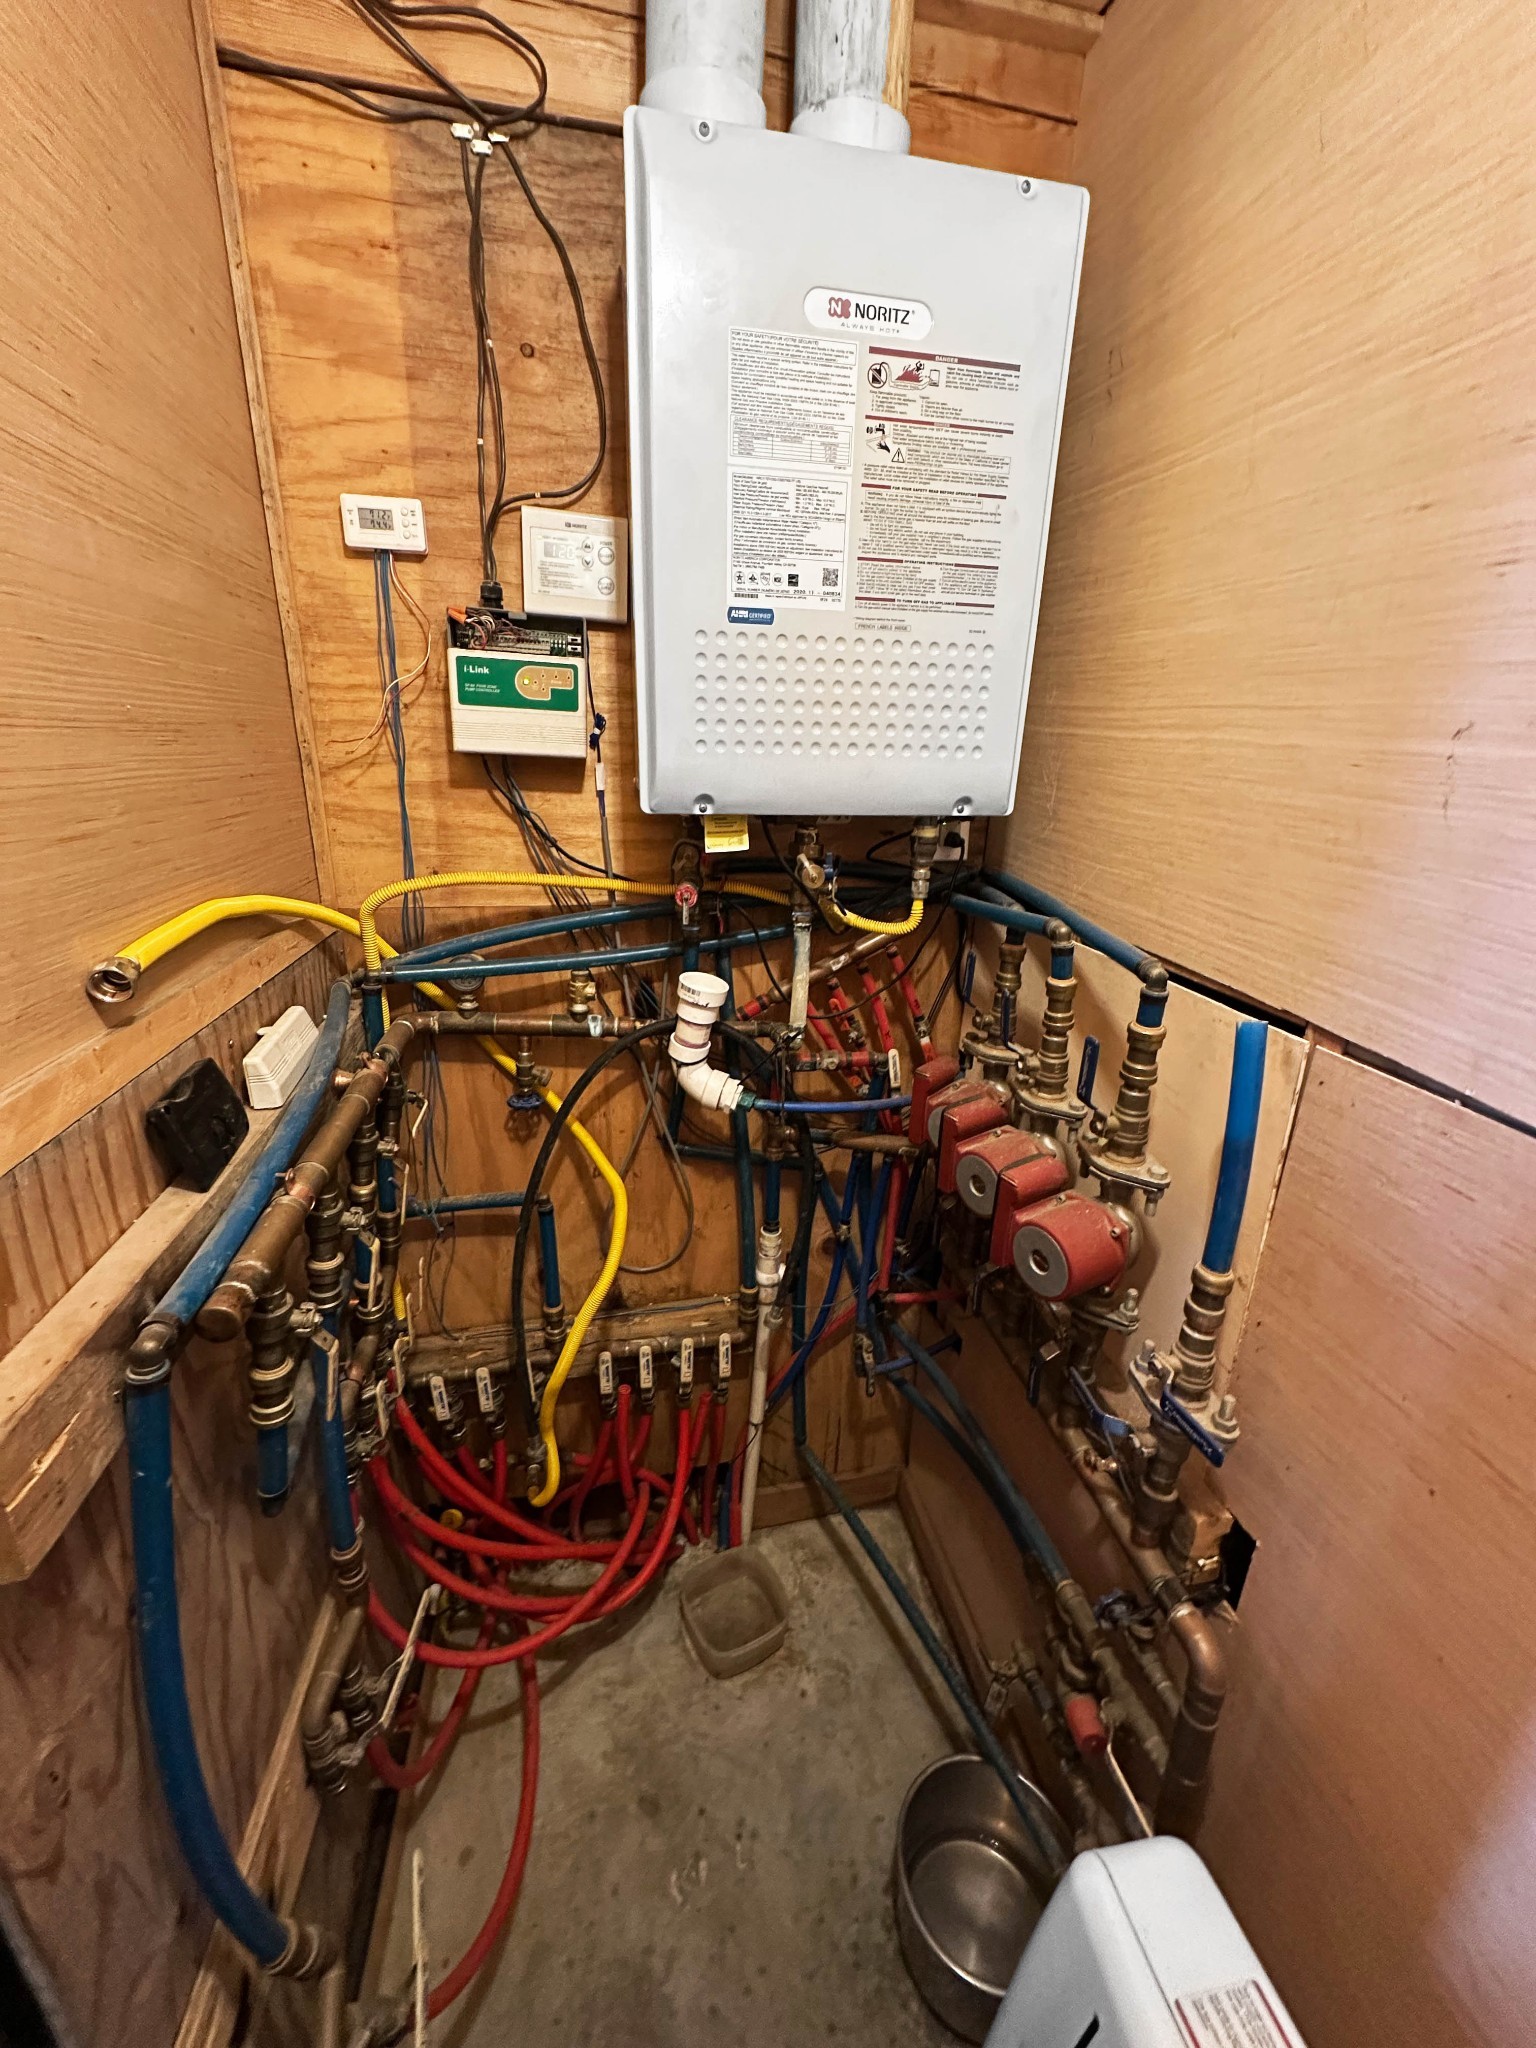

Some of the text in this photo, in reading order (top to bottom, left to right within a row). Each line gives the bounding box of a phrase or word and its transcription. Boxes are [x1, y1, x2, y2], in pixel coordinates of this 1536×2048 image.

[855, 303, 910, 325] NORITZ
[840, 322, 875, 332] ALWAYS
[935, 355, 959, 364] DANGER
[463, 665, 490, 674] i-Link
